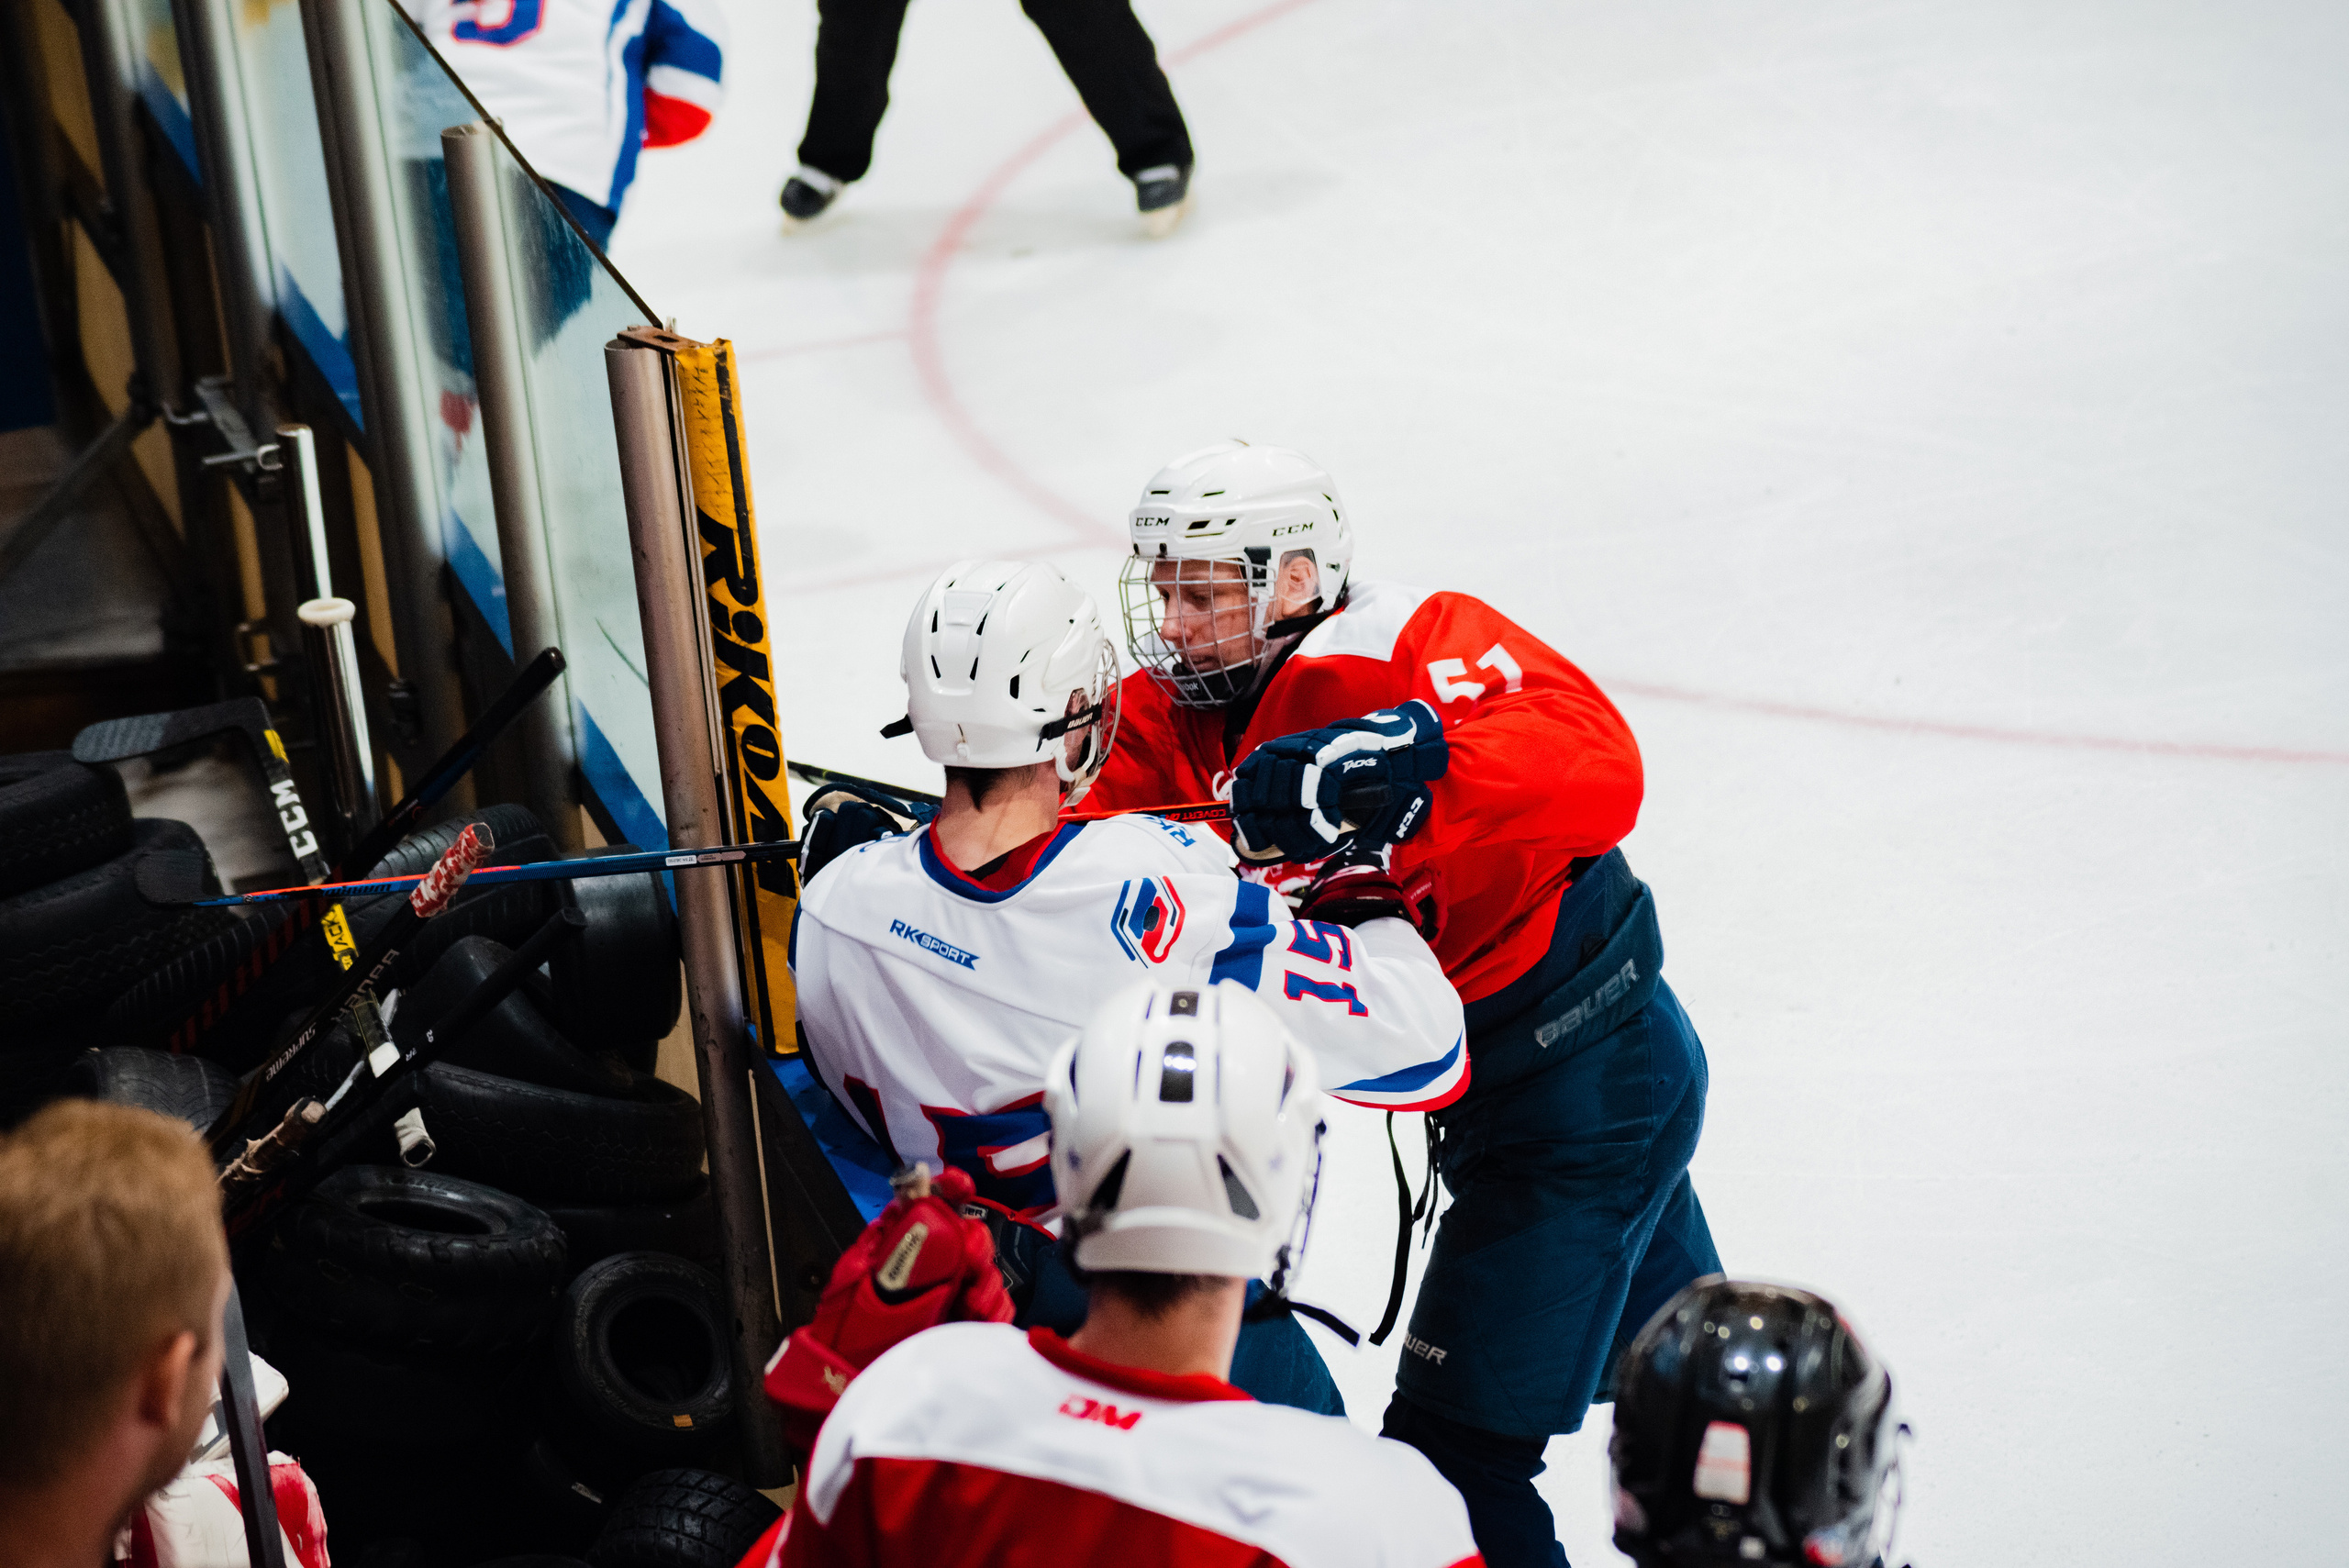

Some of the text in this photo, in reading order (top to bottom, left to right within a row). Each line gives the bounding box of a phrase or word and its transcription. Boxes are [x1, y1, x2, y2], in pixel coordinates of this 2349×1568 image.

[1135, 517, 1170, 527] CCM
[1272, 522, 1314, 537] CCM
[270, 779, 319, 859] CCM
[1181, 808, 1227, 820] COVERT
[1396, 796, 1424, 839] CCM
[1284, 918, 1369, 1018] 15
[1534, 958, 1641, 1049] BAUER
[266, 1021, 317, 1083] SUPREME
[1405, 1329, 1448, 1366] UER
